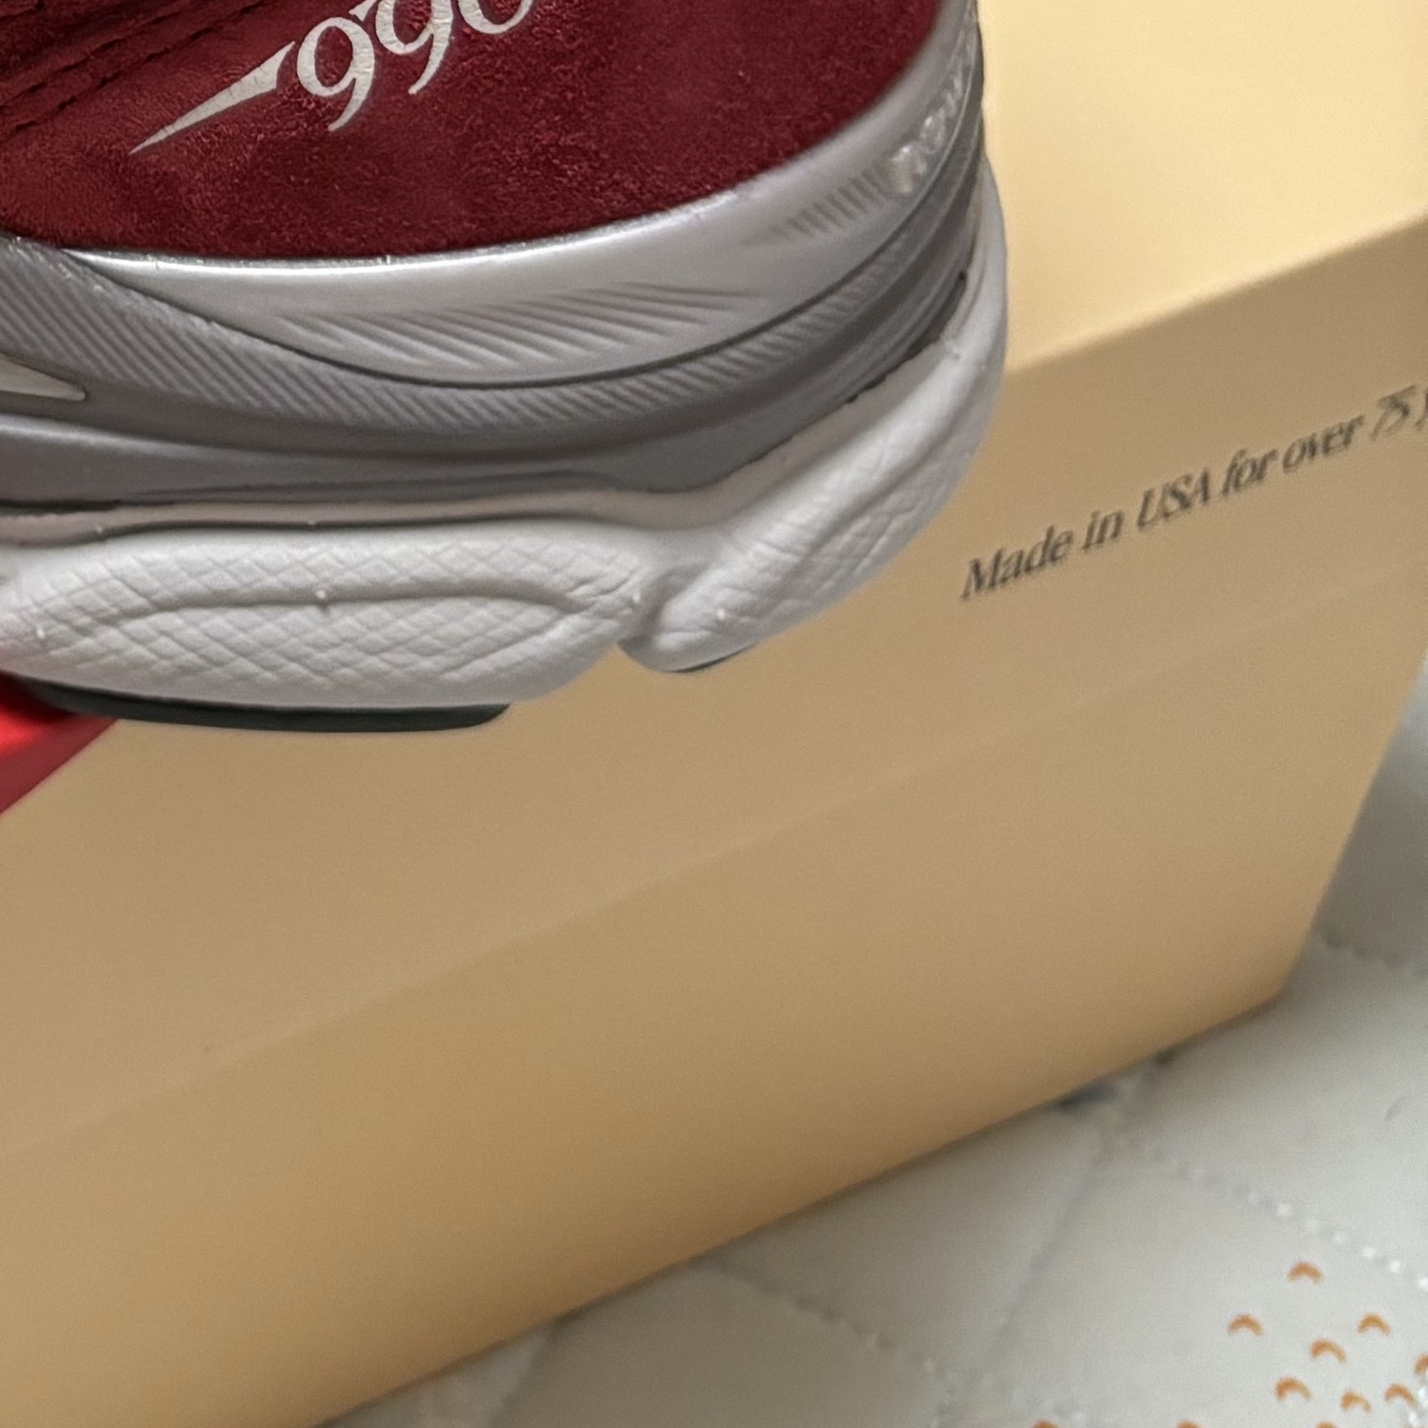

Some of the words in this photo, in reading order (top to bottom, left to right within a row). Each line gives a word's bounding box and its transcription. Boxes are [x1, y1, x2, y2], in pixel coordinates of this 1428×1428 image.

[959, 525, 1074, 599] Made
[1082, 510, 1125, 551] in
[1136, 466, 1212, 532] USA
[1220, 447, 1278, 497] for
[1282, 414, 1366, 473] over
[1369, 383, 1418, 442] 75
